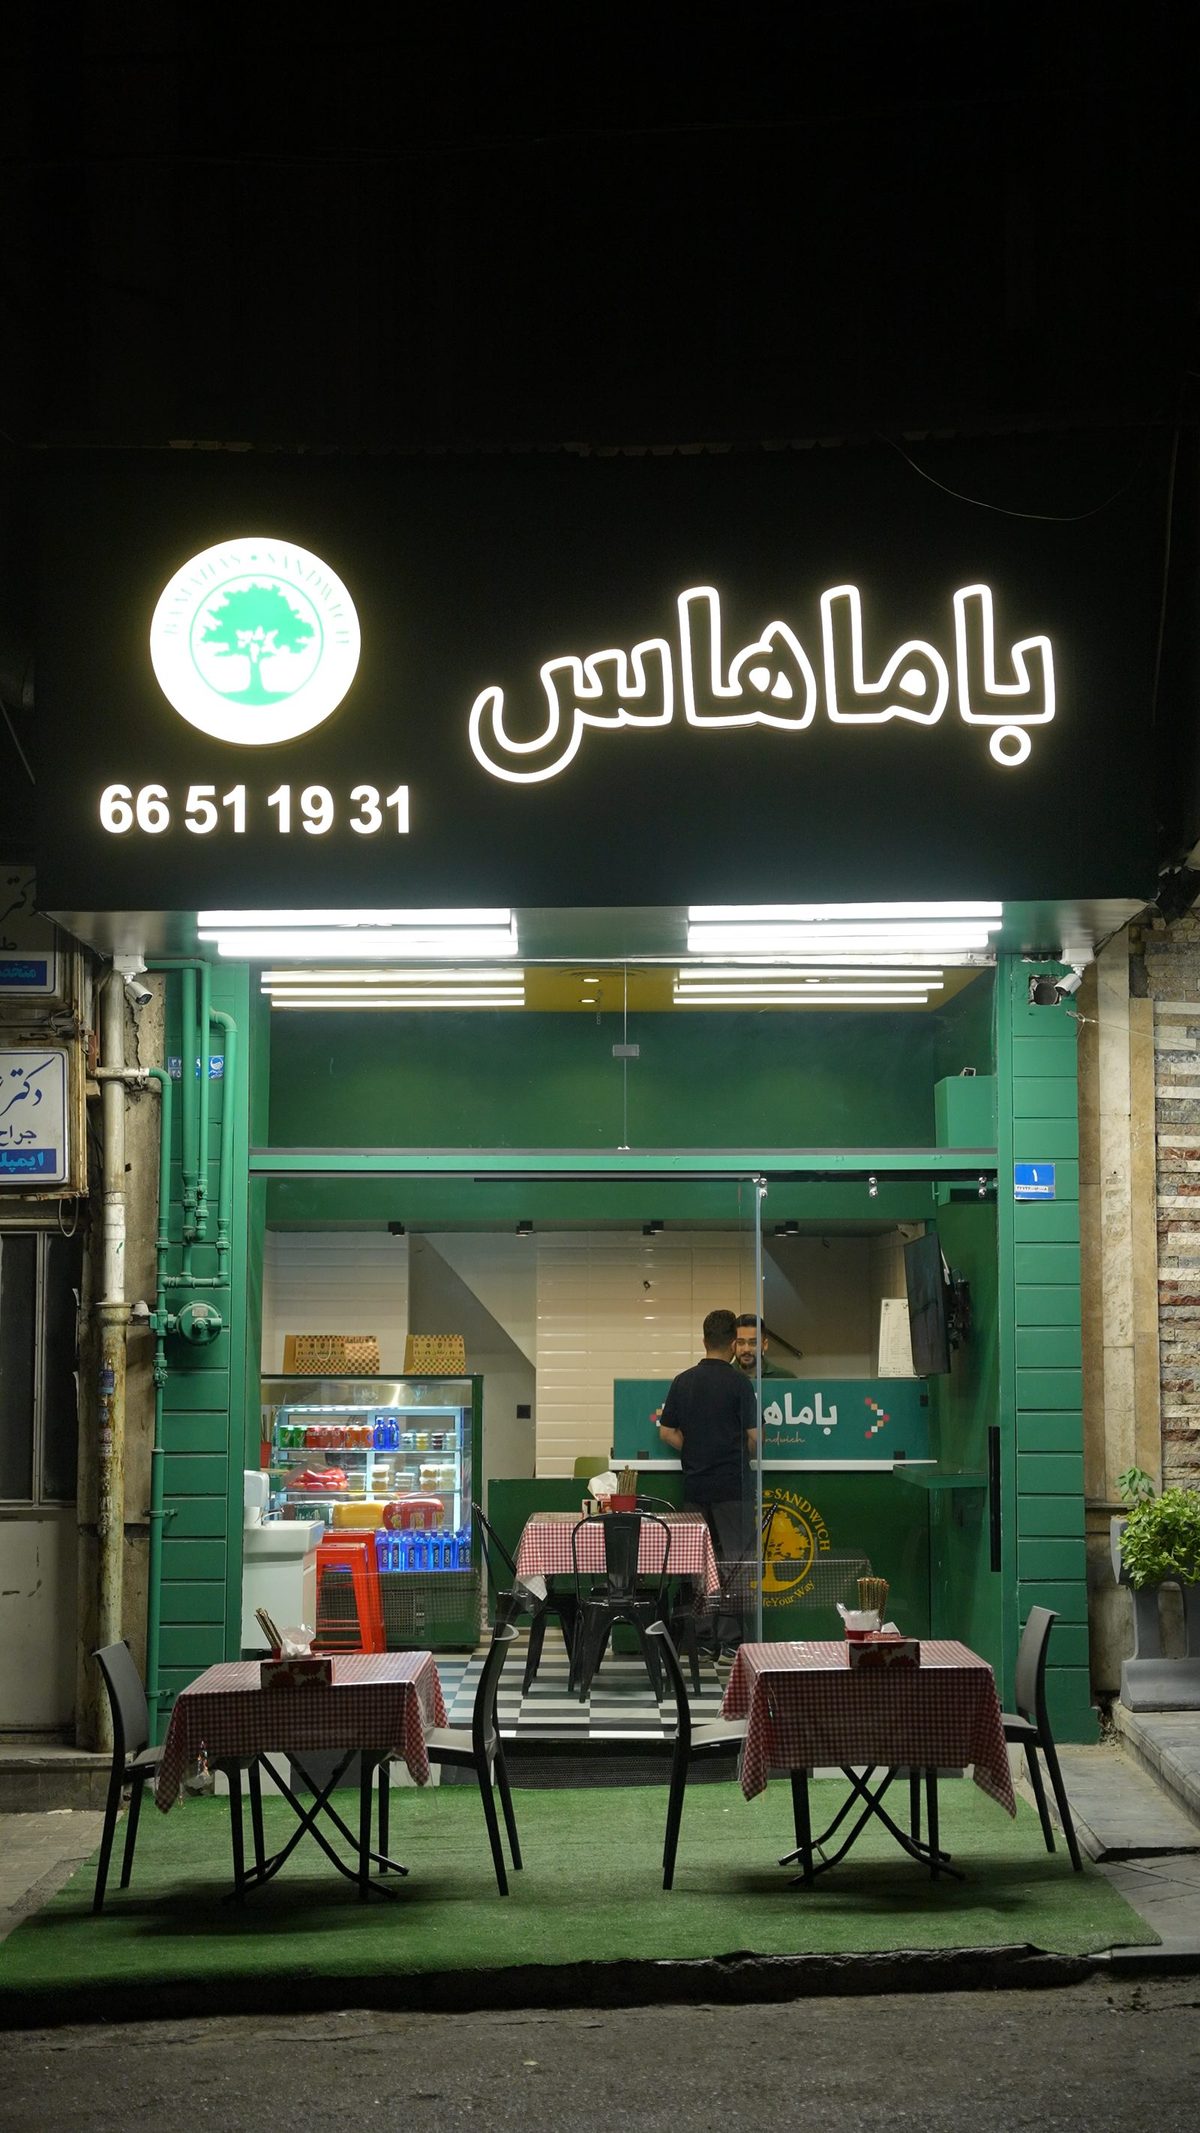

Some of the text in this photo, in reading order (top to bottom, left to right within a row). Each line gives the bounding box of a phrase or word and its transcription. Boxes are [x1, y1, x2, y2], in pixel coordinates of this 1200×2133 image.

[468, 583, 1056, 784] باماهاس
[99, 784, 410, 835] 66 51 19 31
[0, 1056, 55, 1117] دکتر
[1032, 1168, 1038, 1183] ۱
[763, 1392, 838, 1436] باماه
[773, 1487, 831, 1551] SANDWICH
[771, 1595, 794, 1607] Your
[794, 1580, 815, 1597] Way
